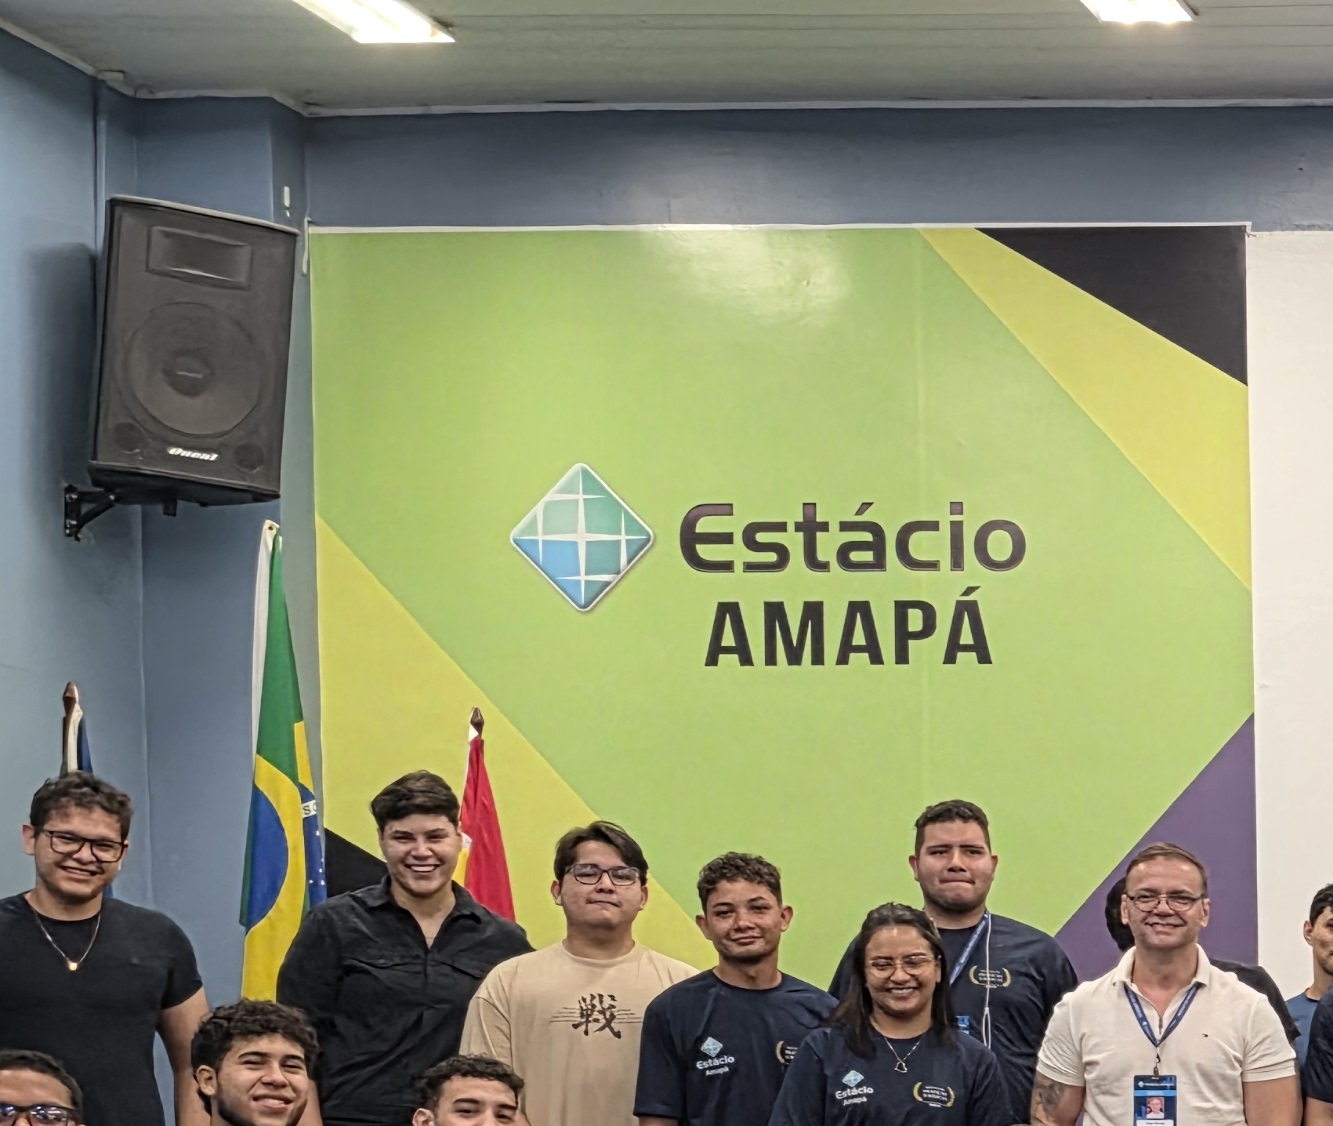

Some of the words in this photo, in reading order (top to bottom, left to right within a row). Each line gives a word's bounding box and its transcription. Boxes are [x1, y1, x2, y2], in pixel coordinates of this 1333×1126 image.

[680, 501, 1026, 573] Estácio
[704, 585, 993, 667] AMAPÁ
[696, 1055, 735, 1069] Estácio
[835, 1086, 874, 1100] Estácio
